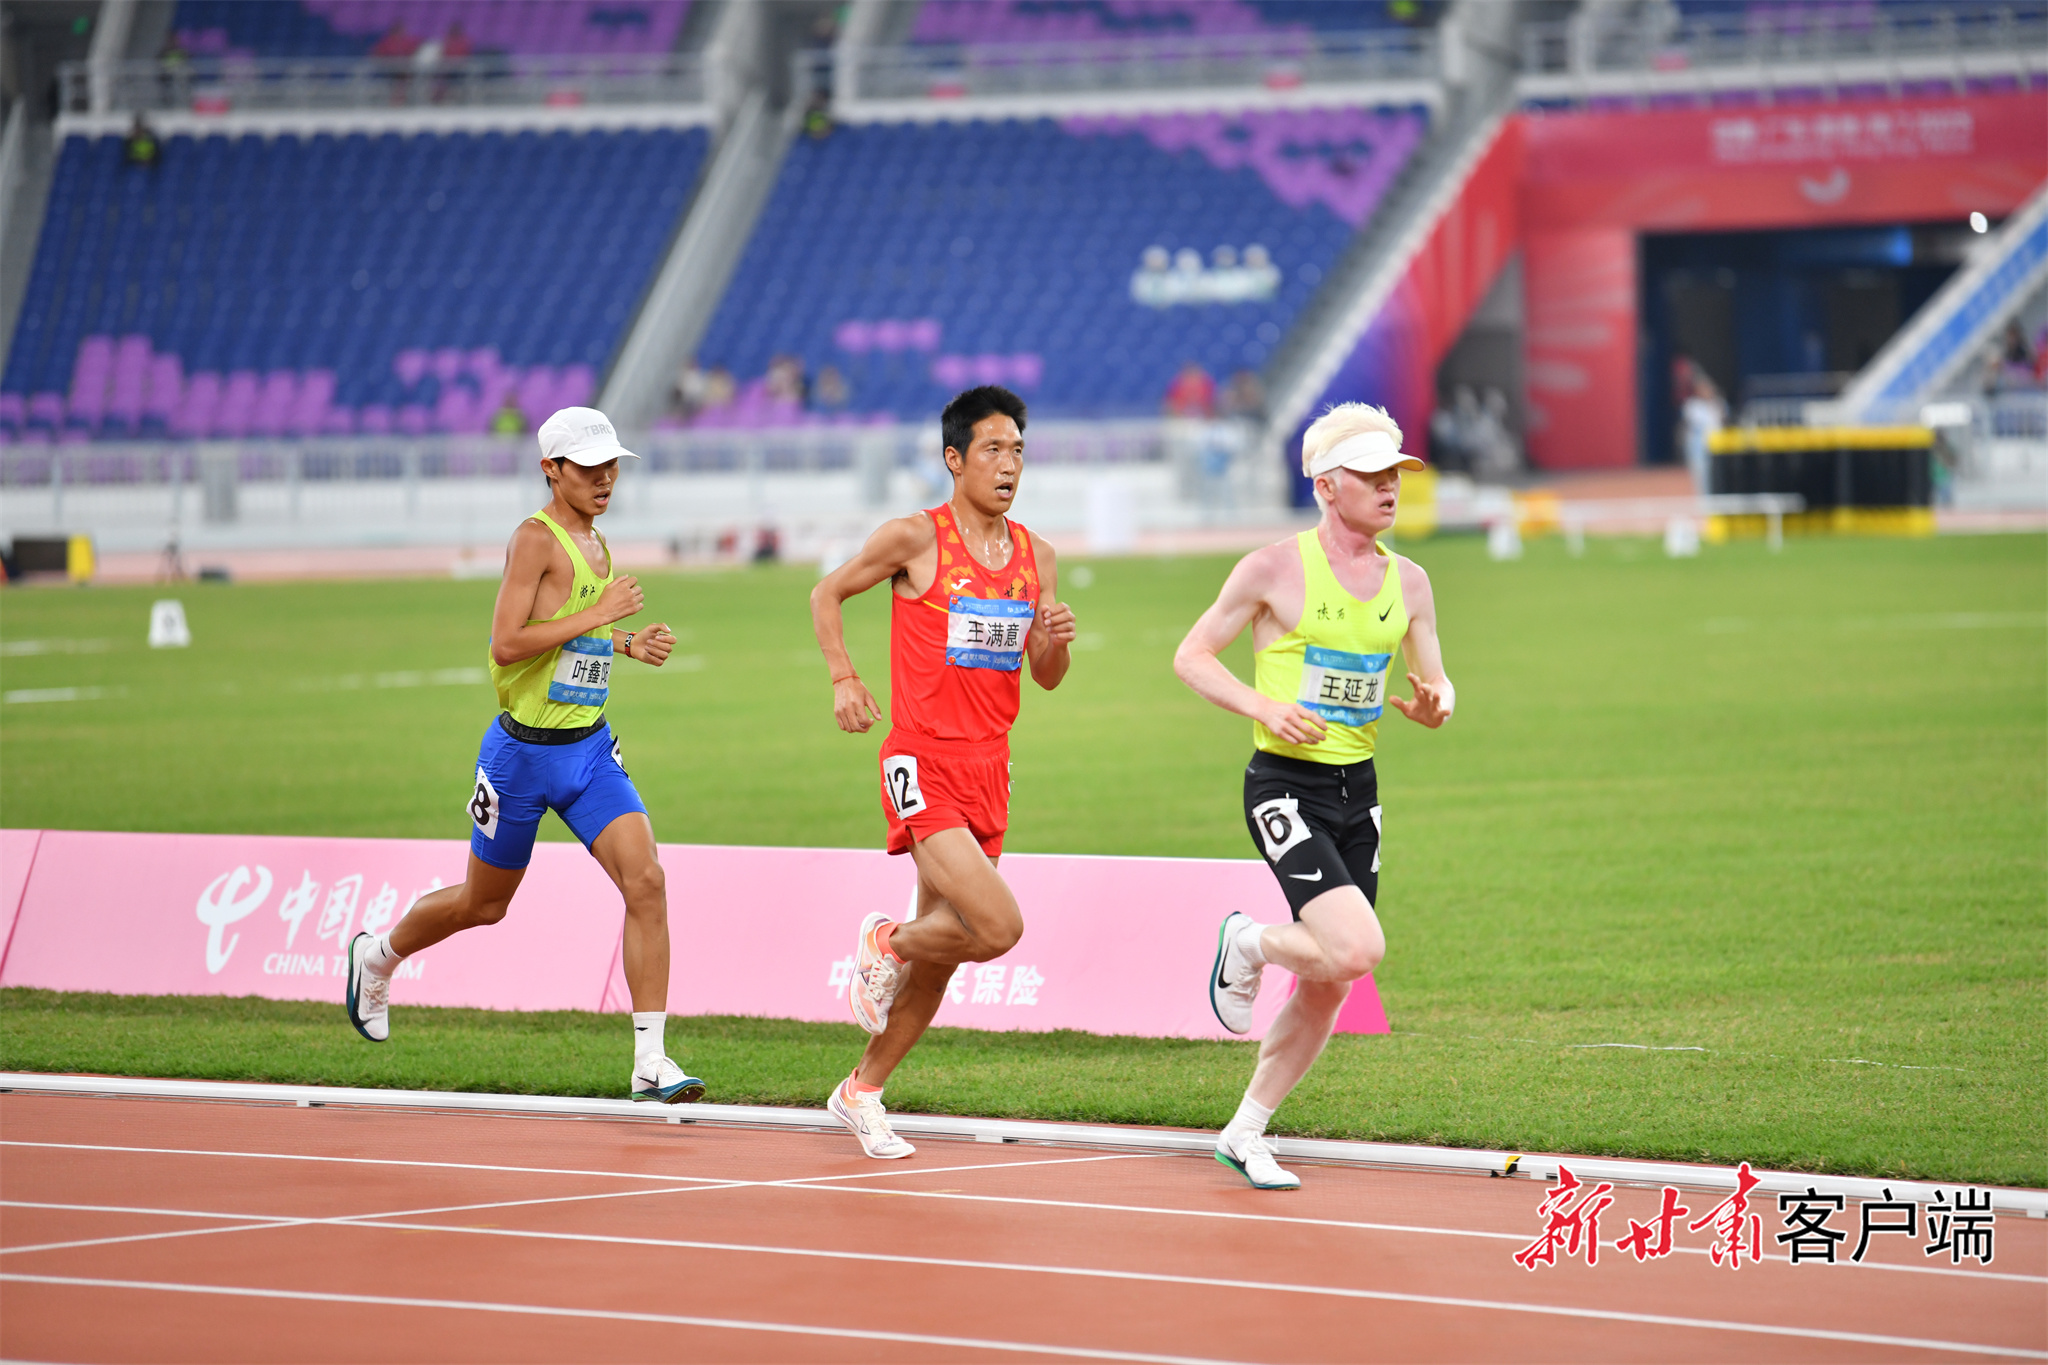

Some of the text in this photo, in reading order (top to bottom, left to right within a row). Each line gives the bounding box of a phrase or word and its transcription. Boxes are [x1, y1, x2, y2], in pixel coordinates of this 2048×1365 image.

[582, 423, 613, 438] TBRC
[967, 620, 1020, 648] 王满意
[1319, 675, 1379, 703] 王延龙
[471, 782, 491, 825] 8
[887, 766, 918, 811] 12
[1261, 806, 1292, 846] 6
[278, 869, 447, 951] 中国电
[263, 952, 325, 977] CHINA
[827, 955, 1046, 1006] 中民保险
